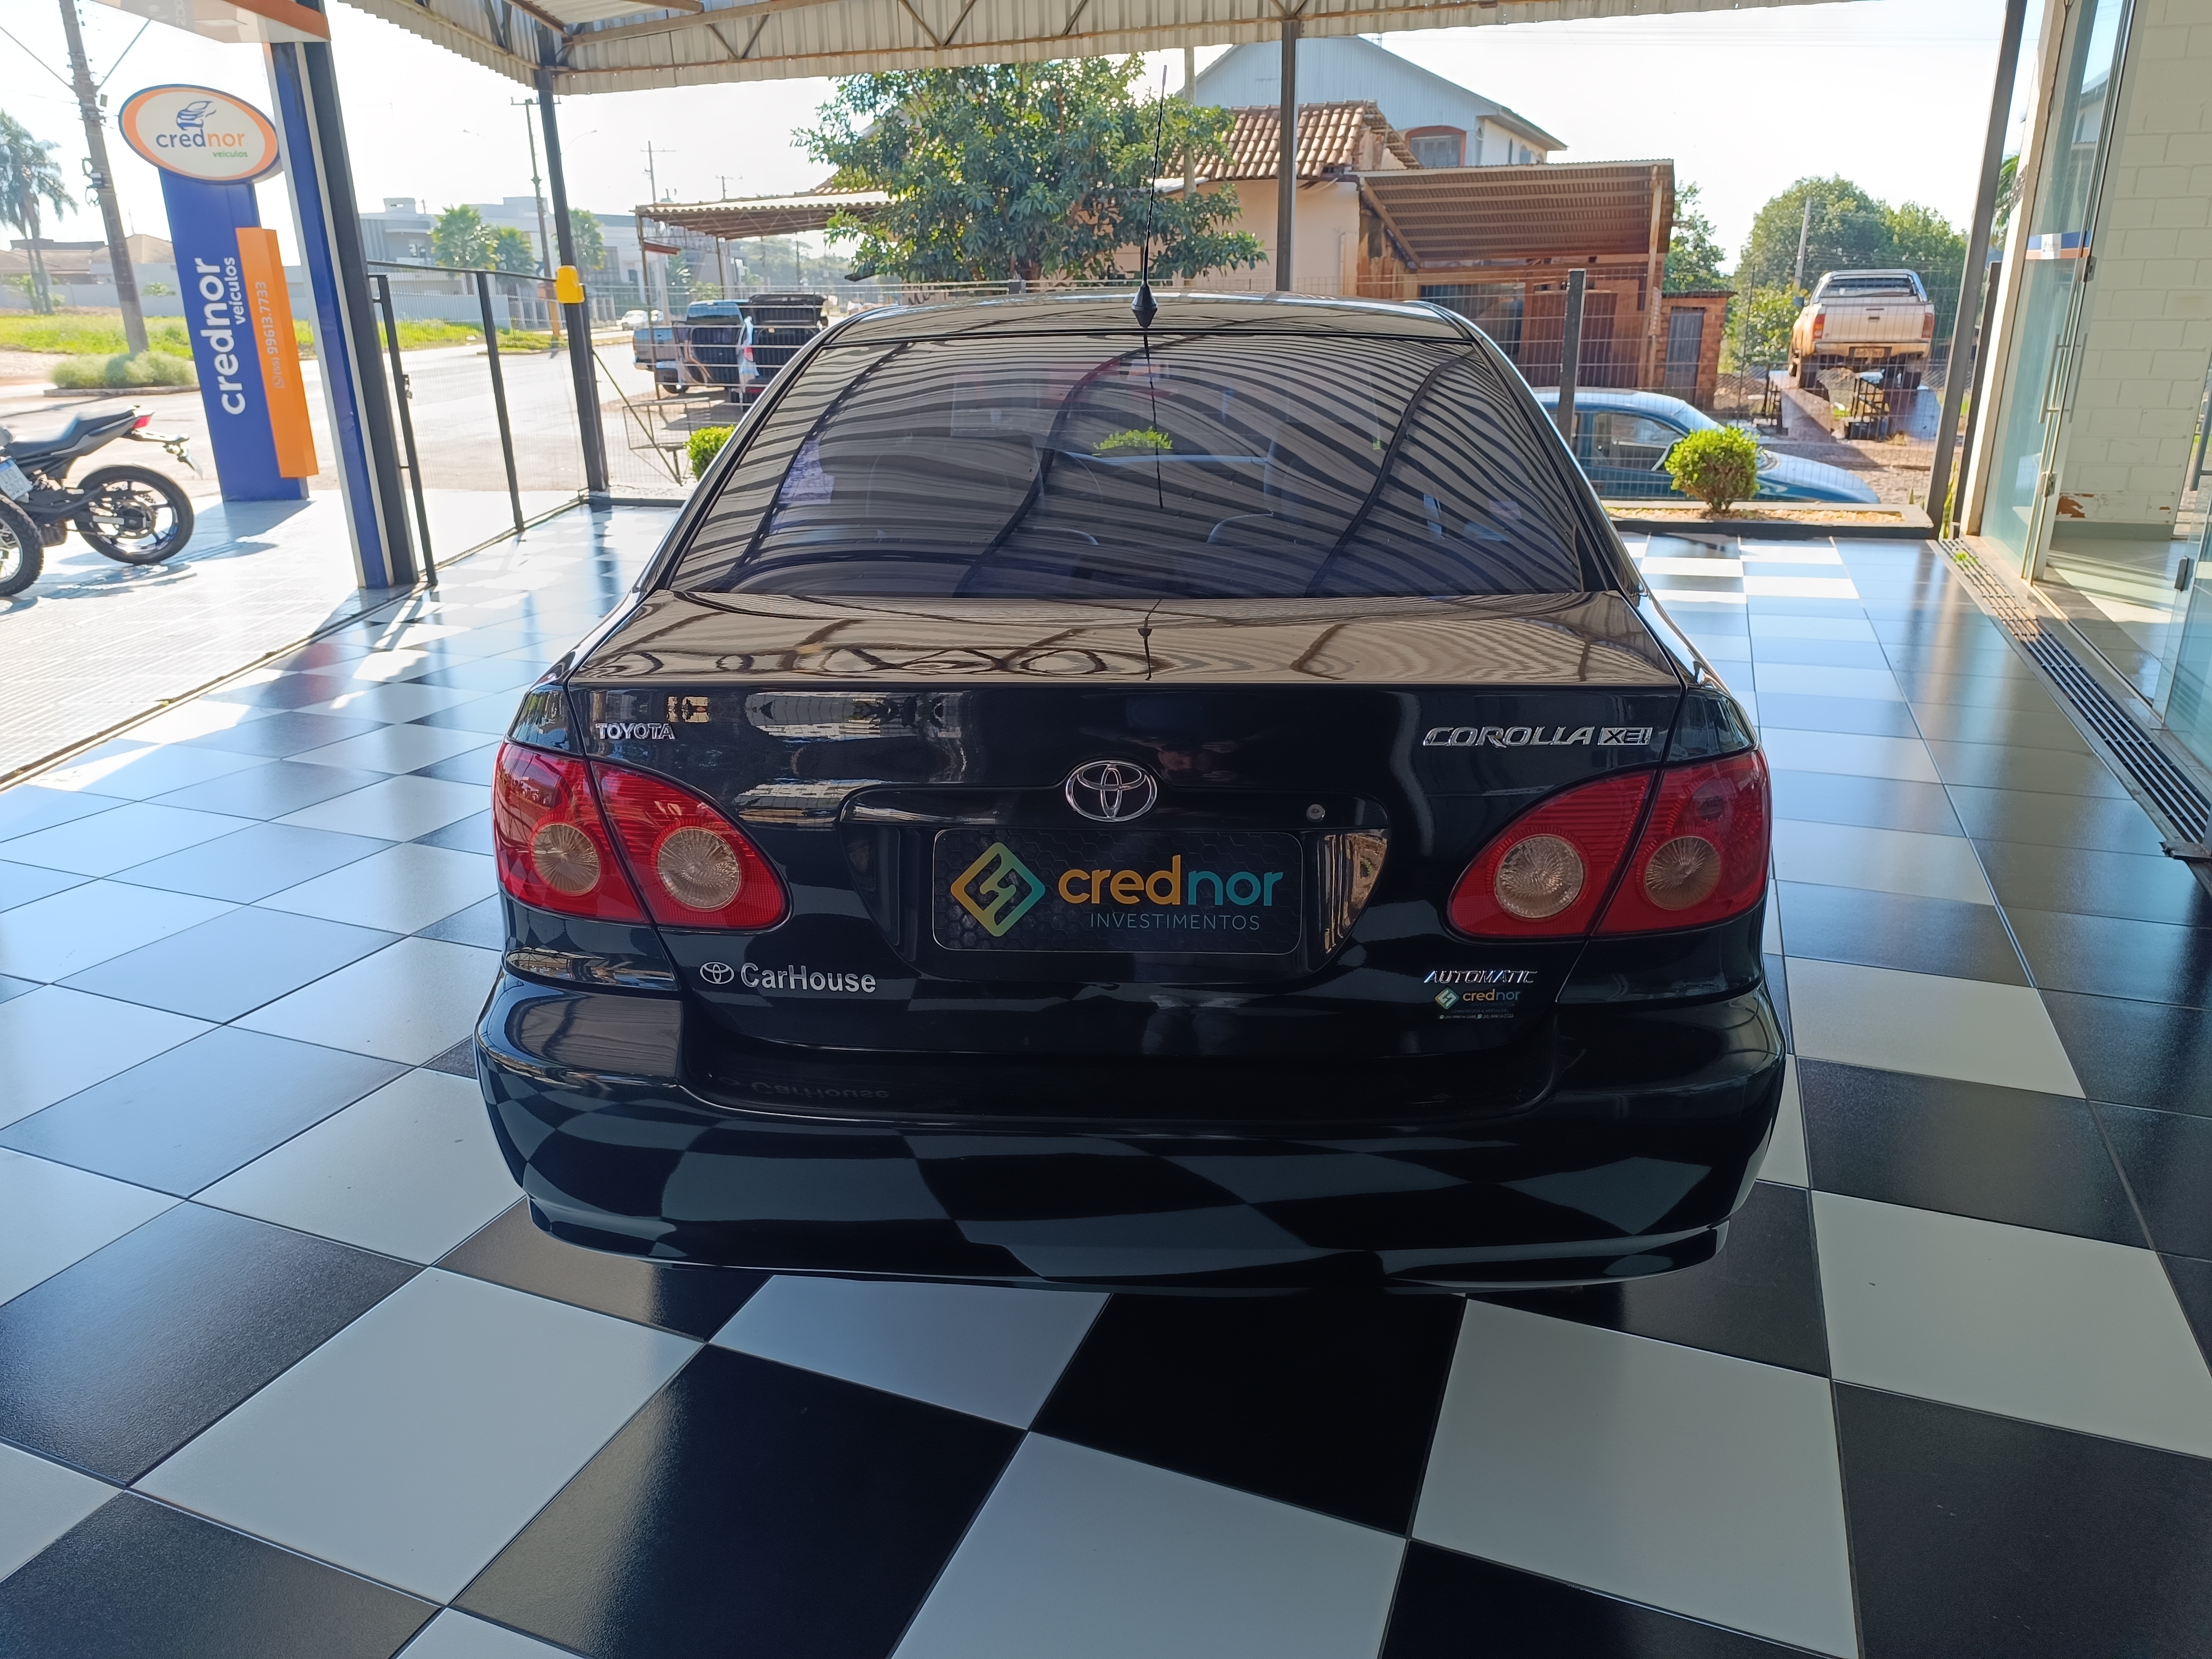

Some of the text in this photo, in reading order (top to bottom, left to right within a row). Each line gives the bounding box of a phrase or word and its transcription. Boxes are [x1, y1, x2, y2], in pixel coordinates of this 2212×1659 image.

[156, 128, 245, 148] crednor
[255, 281, 278, 355] 99613.7733
[194, 258, 246, 415] crednor
[595, 723, 677, 740] TOYOTA
[1422, 726, 1595, 748] COROLLA
[1058, 854, 1284, 906] crednor
[1090, 912, 1261, 931] INVESTIMENTOS
[741, 962, 877, 993] CarHouse
[1424, 970, 1538, 984] AUTOMATIC
[1462, 988, 1521, 1002] crednor
